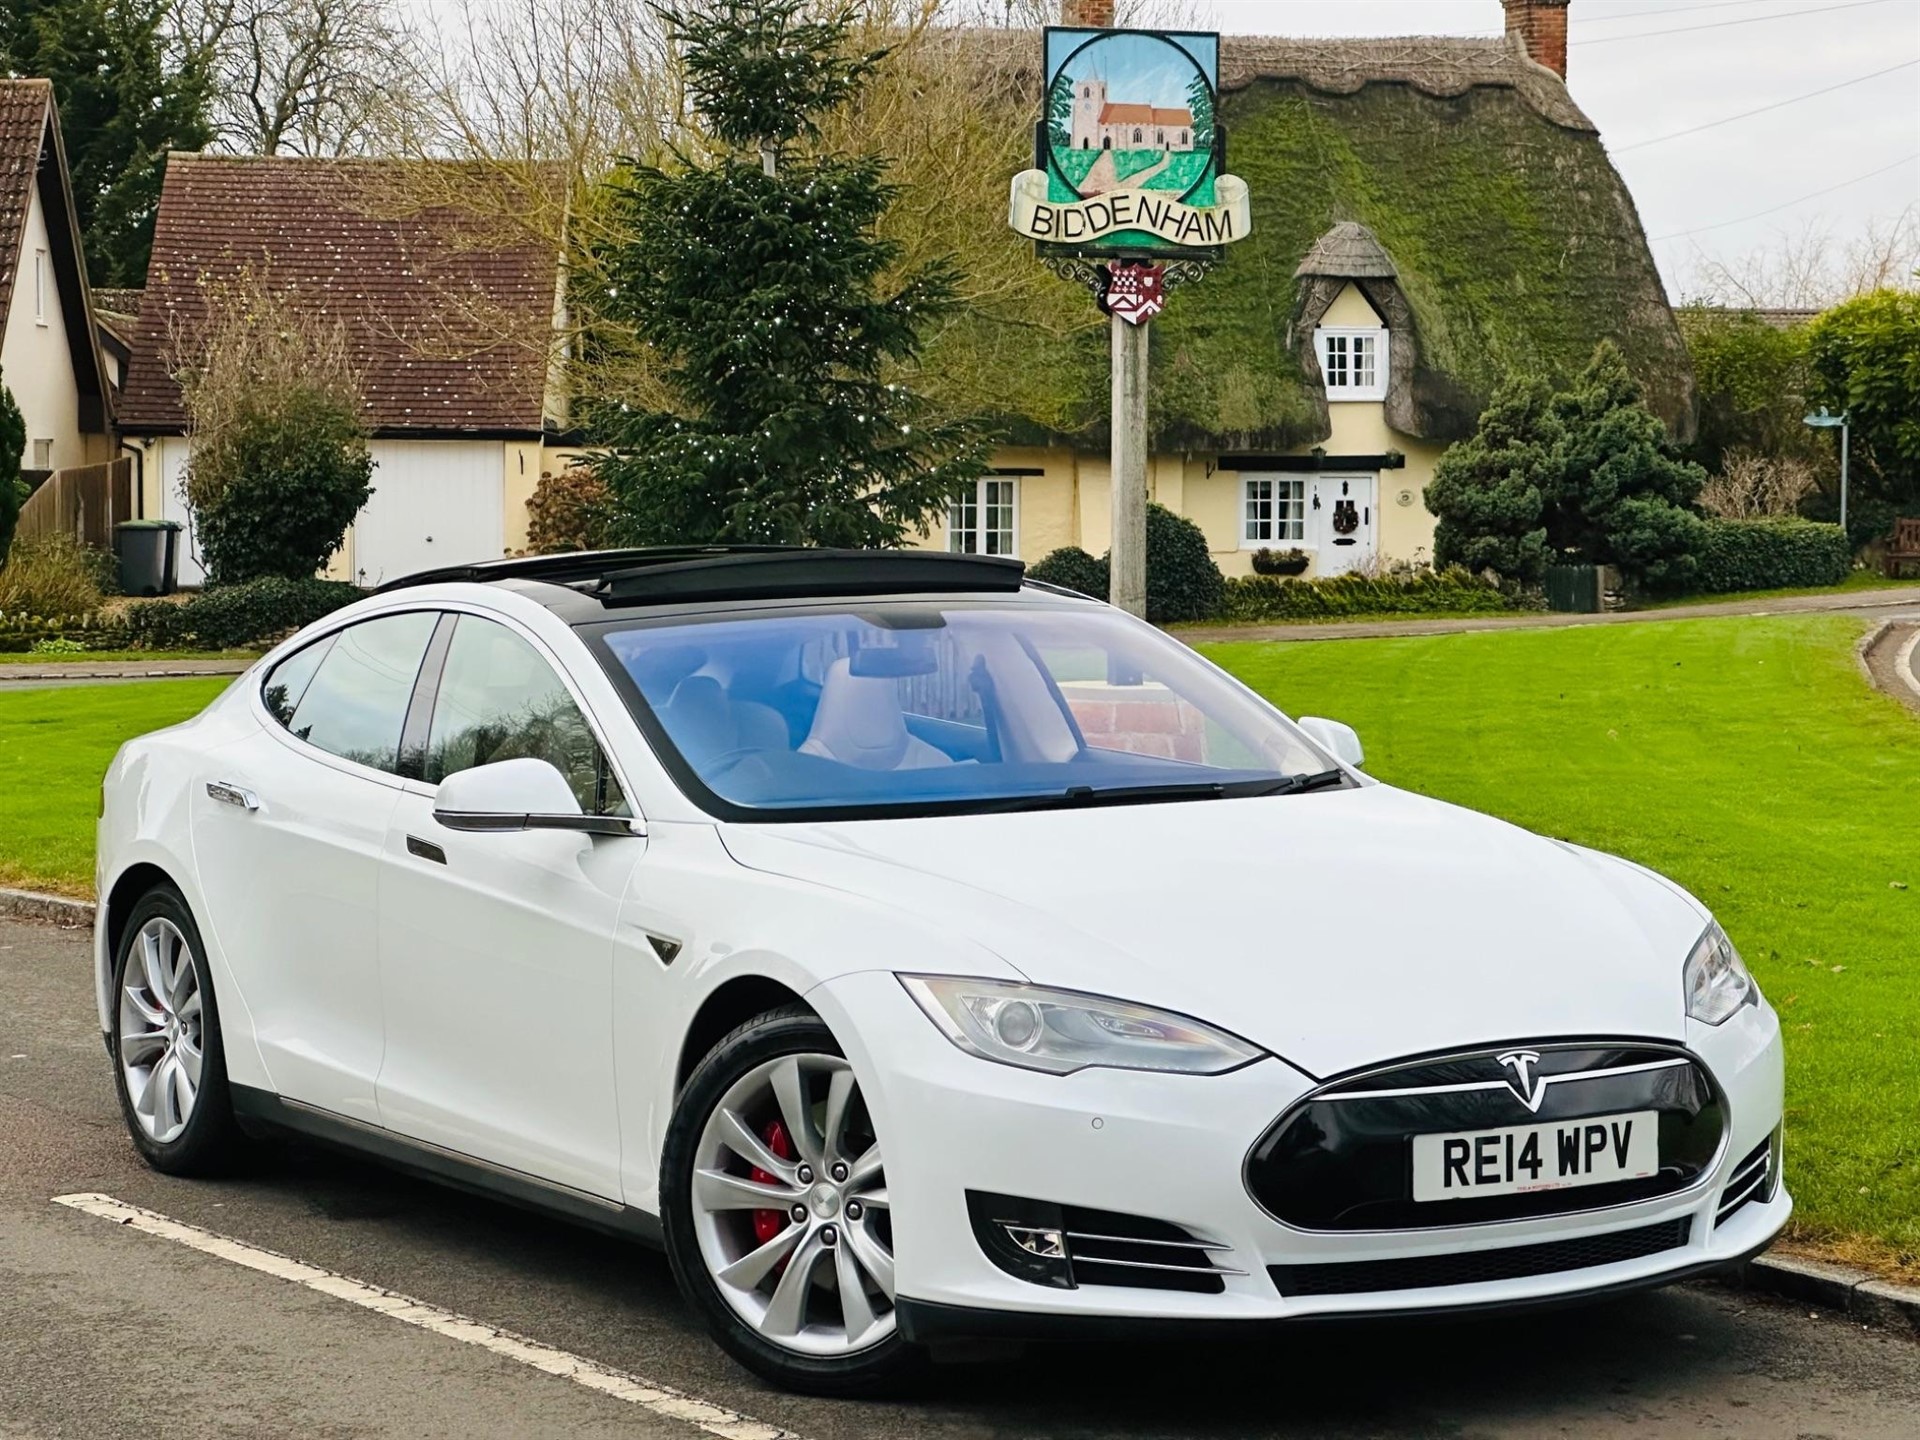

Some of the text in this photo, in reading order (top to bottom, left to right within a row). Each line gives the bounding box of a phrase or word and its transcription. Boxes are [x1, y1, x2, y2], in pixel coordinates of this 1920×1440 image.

[1031, 195, 1232, 241] BIDDENHAM
[1443, 1121, 1632, 1188] RE14 WPV
